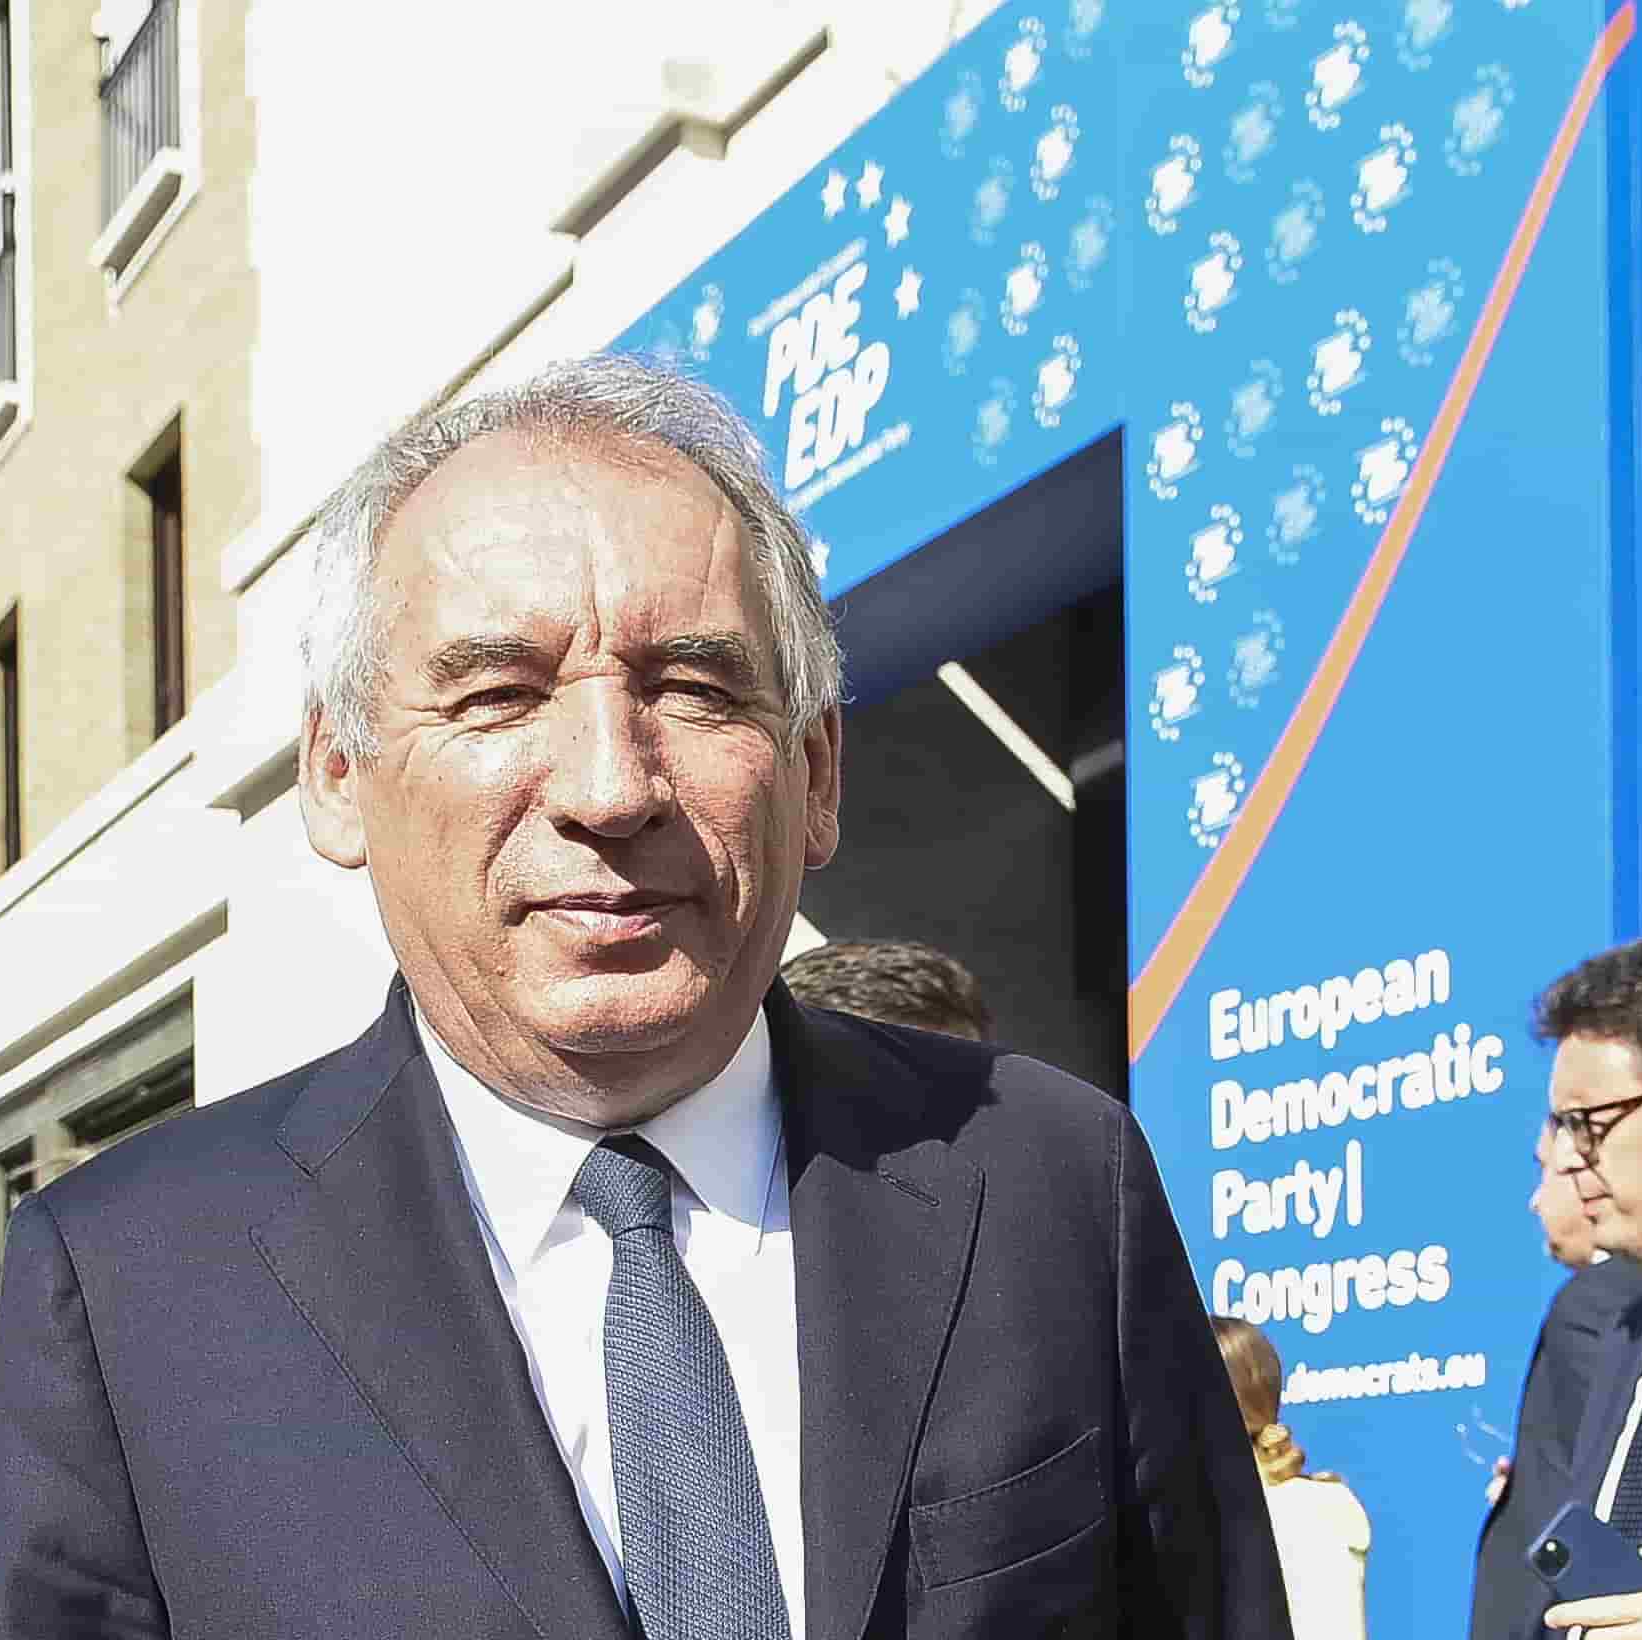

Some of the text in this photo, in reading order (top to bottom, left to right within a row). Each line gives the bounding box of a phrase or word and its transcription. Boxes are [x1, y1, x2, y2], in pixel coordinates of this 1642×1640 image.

[1209, 948, 1451, 1060] European
[1211, 1022, 1503, 1149] Democratic
[1212, 1245, 1451, 1334] Congress
